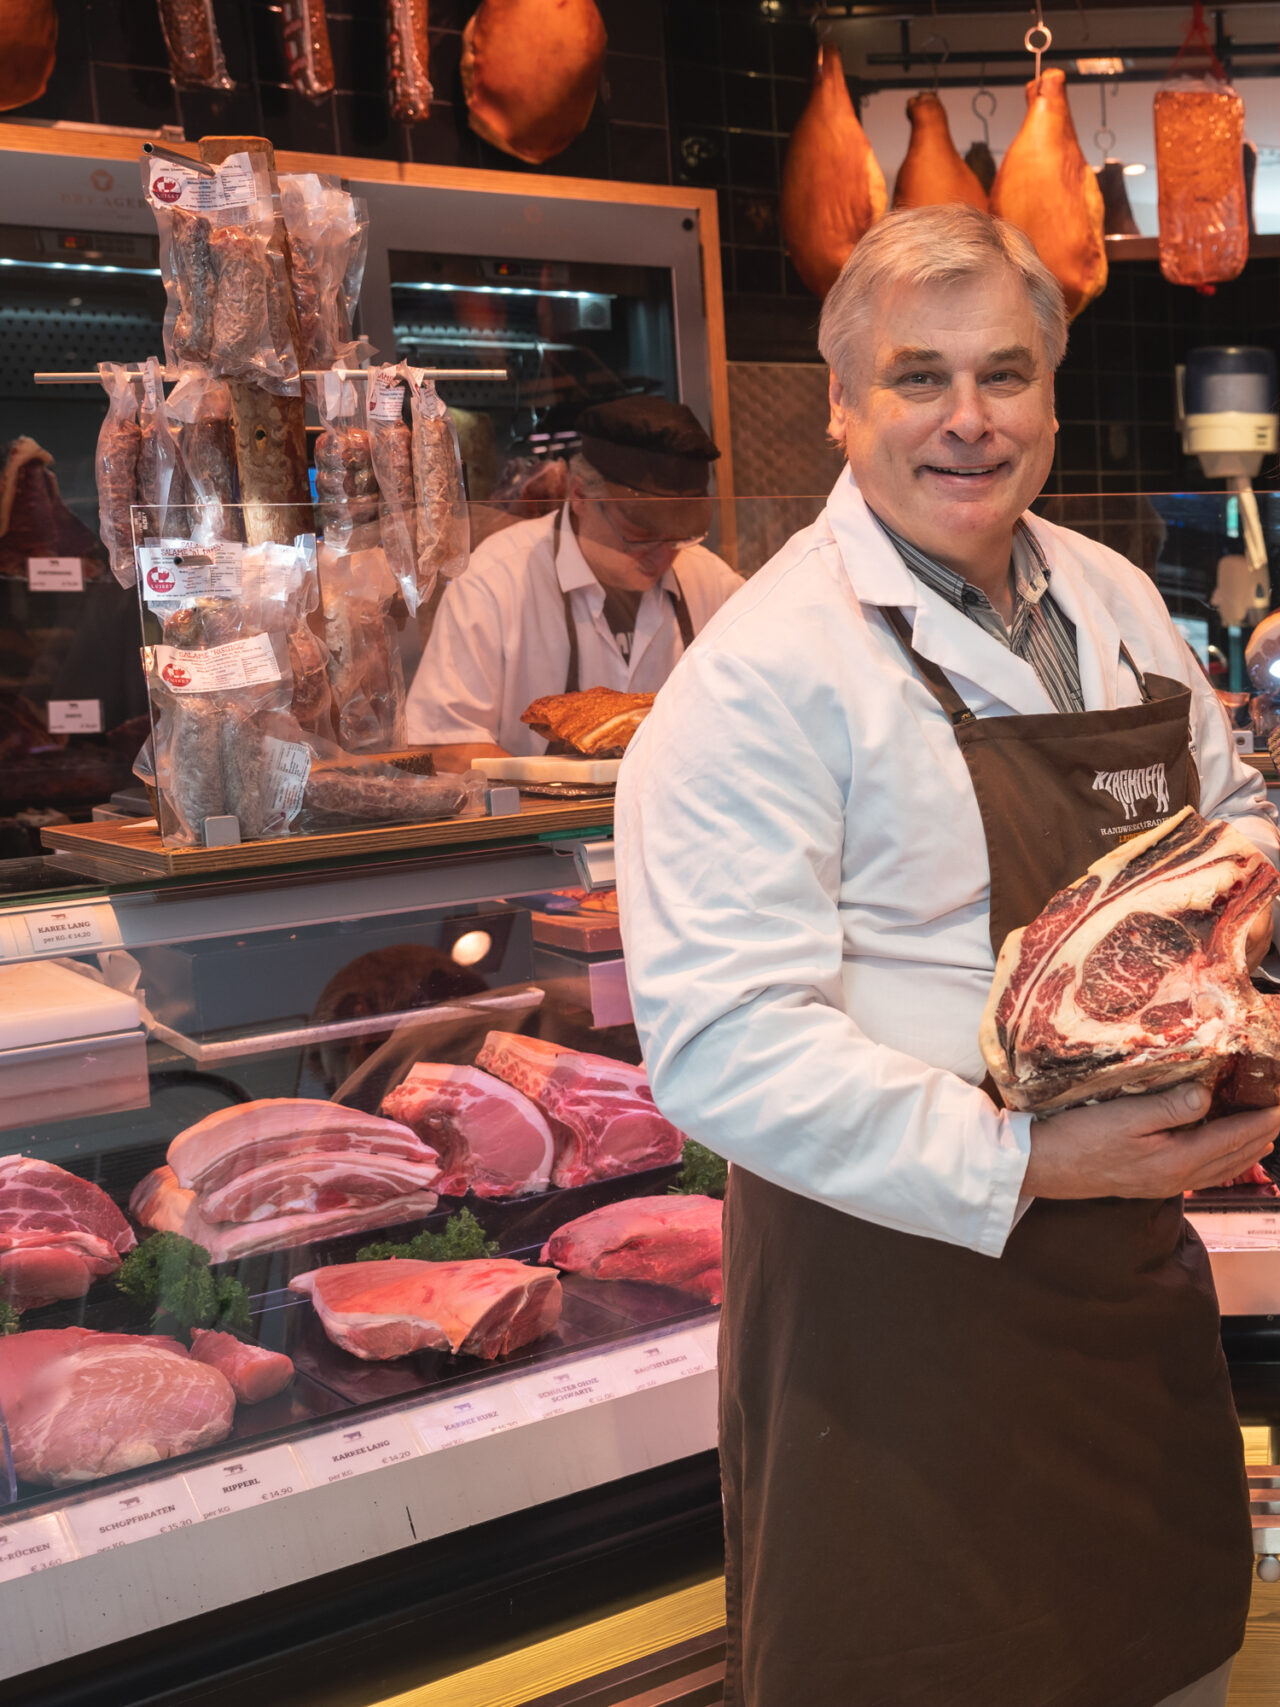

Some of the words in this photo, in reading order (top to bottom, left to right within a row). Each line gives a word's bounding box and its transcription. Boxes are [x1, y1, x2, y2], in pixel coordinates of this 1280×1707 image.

[67, 921, 91, 930] LANG
[332, 1448, 366, 1463] KARREE
[367, 1440, 391, 1452] LANG
[222, 1478, 261, 1495] RIPPERL
[99, 1504, 176, 1534] SCHOPFBRATEN
[0, 1542, 51, 1563] -RÜCKEN
